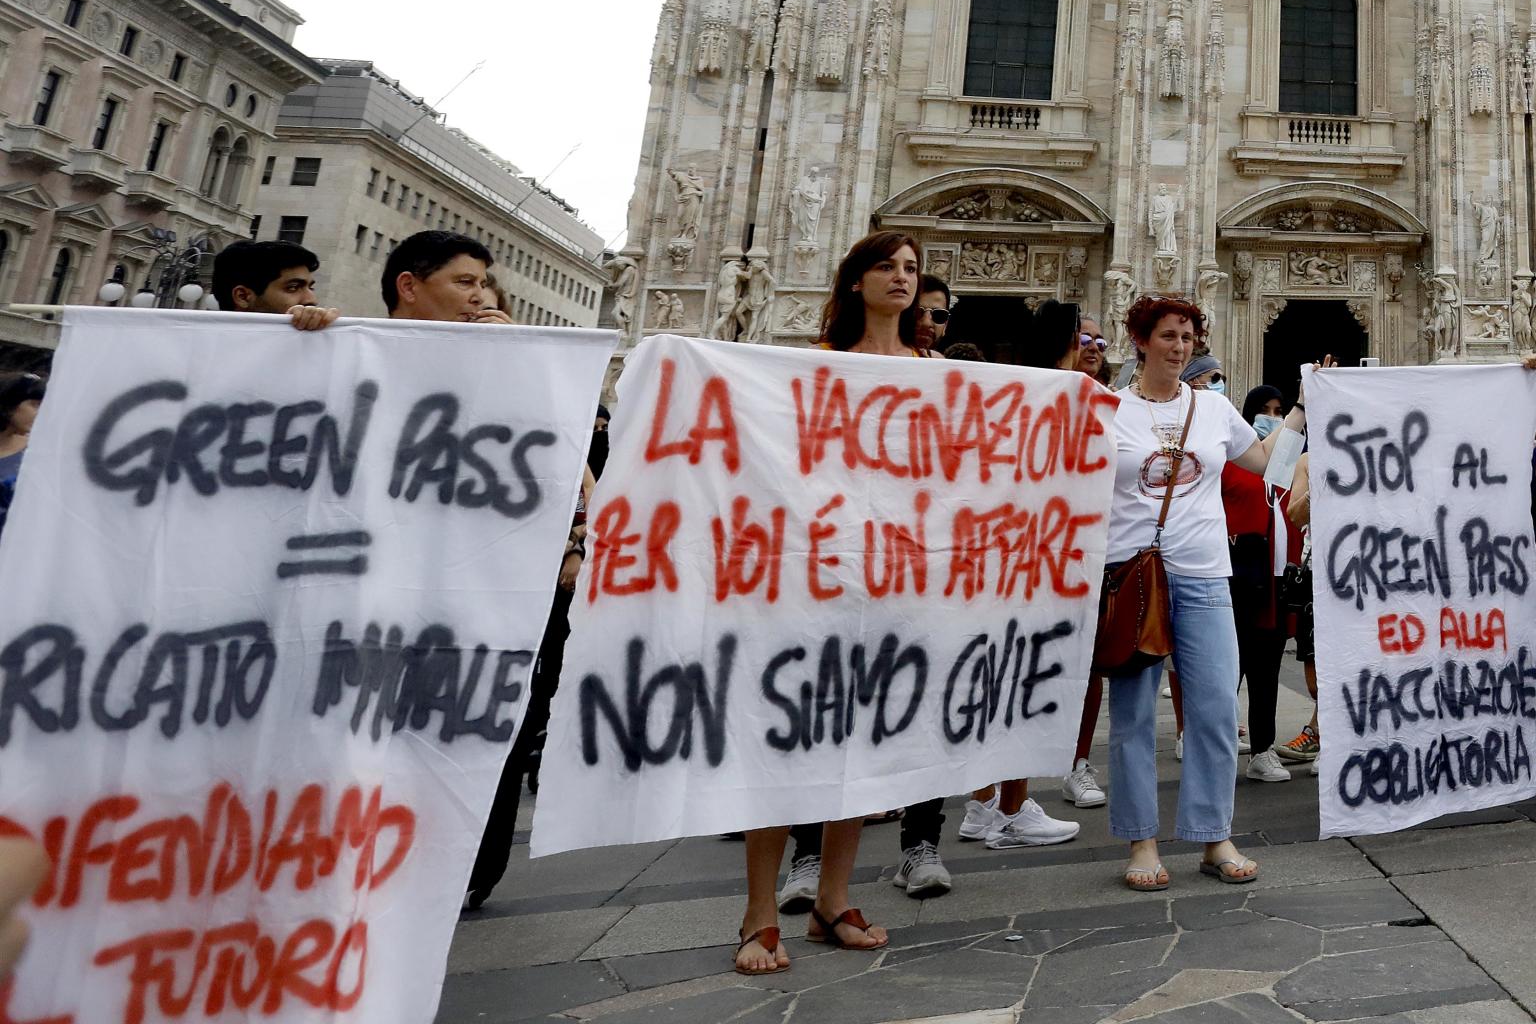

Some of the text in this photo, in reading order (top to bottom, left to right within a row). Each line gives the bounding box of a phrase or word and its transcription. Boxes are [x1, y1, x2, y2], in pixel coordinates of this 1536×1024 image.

[83, 379, 557, 518] GREEN PASS
[645, 357, 1121, 483] LA VACCINAZIONE
[1325, 409, 1507, 496] STOP AL
[587, 494, 681, 604] PER
[711, 494, 784, 604] VOI
[863, 490, 930, 599] UN
[943, 495, 1104, 602] AFFARE
[1327, 503, 1530, 611] GREEN PASS
[0, 620, 277, 748] RICATTO
[1377, 606, 1508, 654] ED ALLA
[579, 618, 1075, 773] NON SIAMO CAVIE
[1338, 725, 1532, 807] OBBLIGATORIA
[93, 917, 368, 1024] FUTURO
